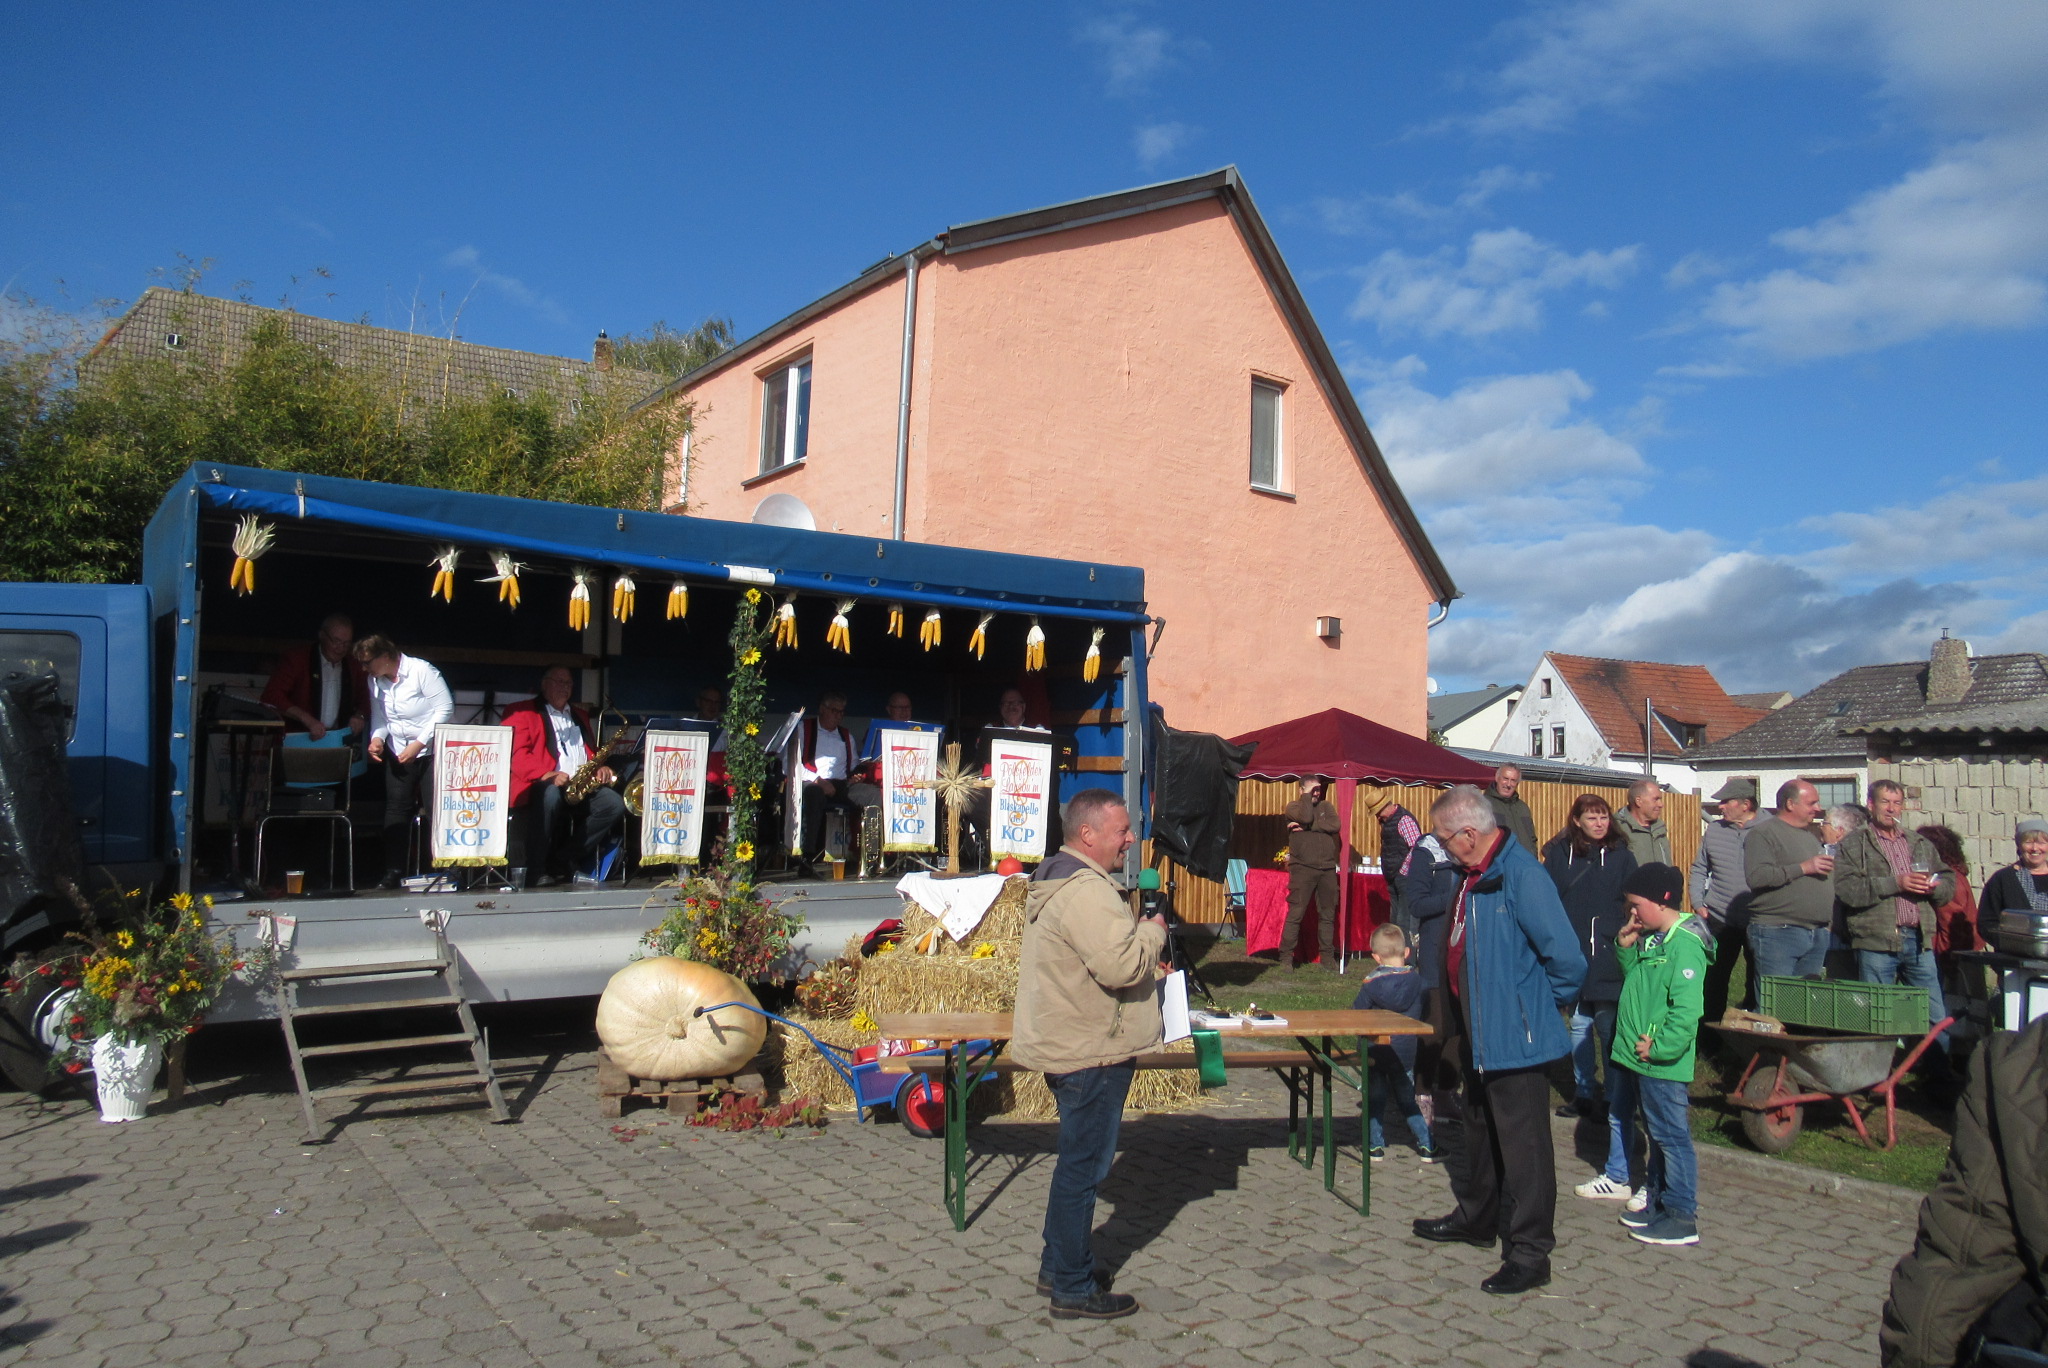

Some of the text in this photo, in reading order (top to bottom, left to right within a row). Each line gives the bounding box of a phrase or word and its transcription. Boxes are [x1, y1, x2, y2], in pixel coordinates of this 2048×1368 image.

[443, 796, 495, 814] Blaskapelle
[652, 797, 692, 814] Blaskapelle
[1000, 799, 1039, 815] Blaskapelle
[460, 813, 478, 824] des
[892, 818, 925, 834] KCP
[1010, 814, 1025, 823] des
[445, 828, 490, 846] KCP
[652, 827, 687, 845] KCP
[1001, 824, 1035, 843] KCP
